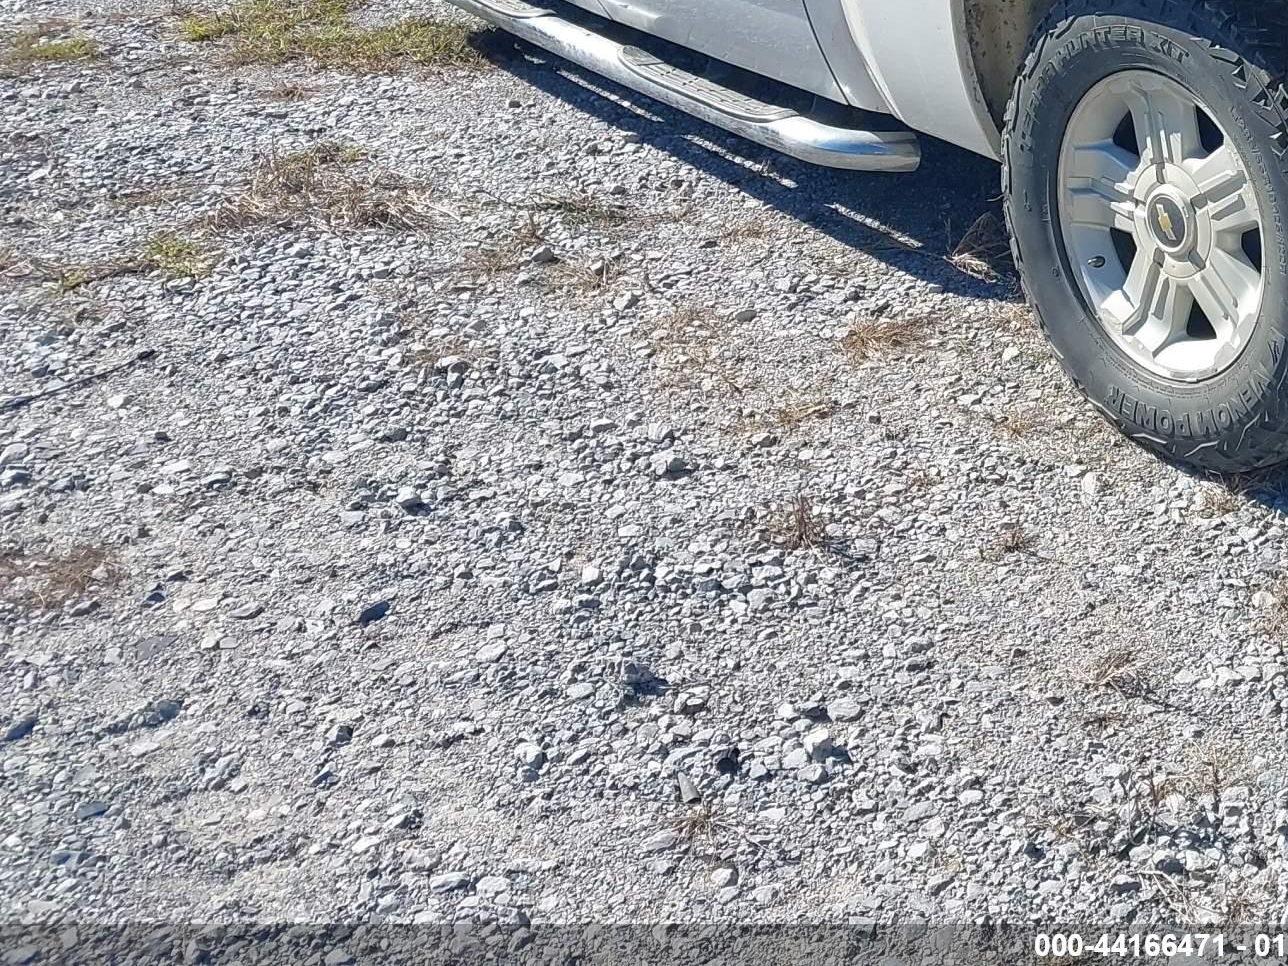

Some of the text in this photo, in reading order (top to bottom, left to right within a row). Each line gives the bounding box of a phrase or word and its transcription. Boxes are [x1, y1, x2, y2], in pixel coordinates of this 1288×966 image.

[1056, 23, 1145, 67] HUNTER
[1104, 361, 1274, 437] VENOM POWER
